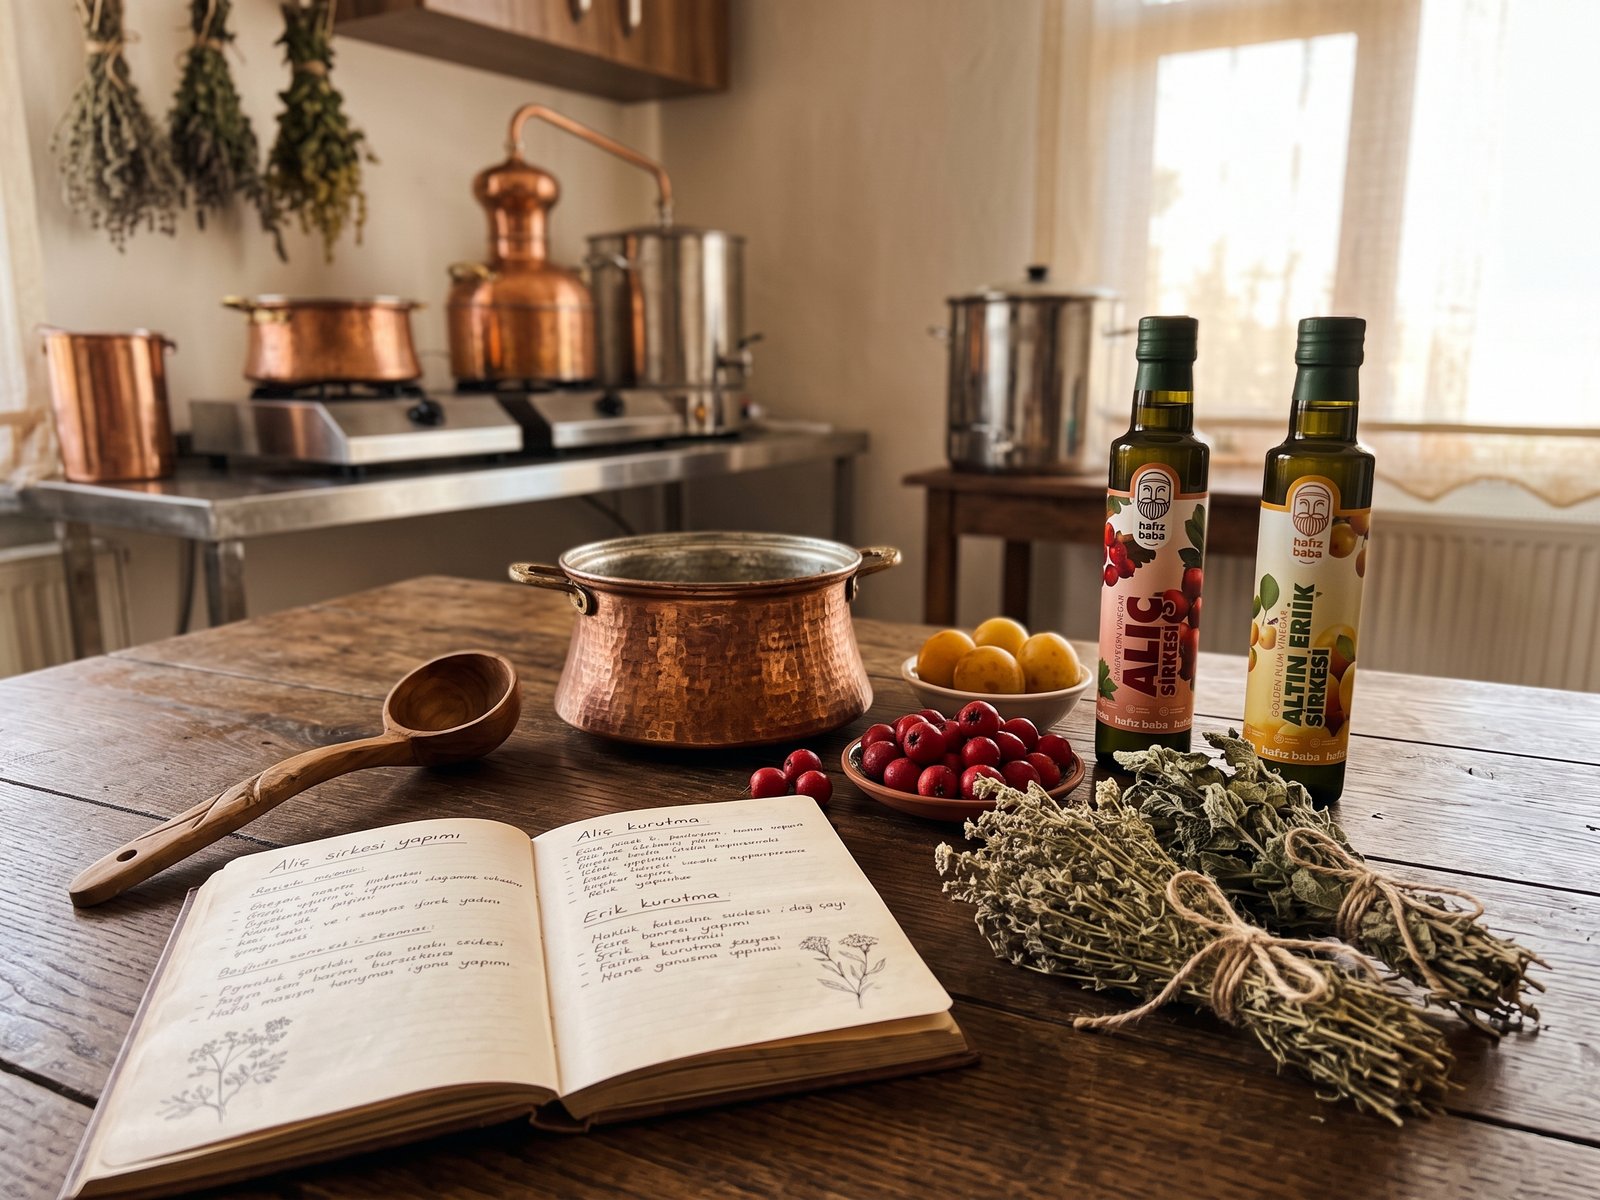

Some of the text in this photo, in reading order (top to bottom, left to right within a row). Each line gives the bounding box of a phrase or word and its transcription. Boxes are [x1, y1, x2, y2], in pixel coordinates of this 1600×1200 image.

[1138, 530, 1165, 540] baba
[1292, 547, 1322, 558] baba
[1271, 610, 1288, 718] GOLDEN PLUM VINEGAR
[1282, 655, 1308, 728] ALTIN
[1141, 720, 1169, 729] baba
[1291, 750, 1320, 761] baba
[576, 817, 700, 842] Aliç kurutma
[269, 858, 310, 874] Aliç
[325, 840, 387, 861] sirkesi
[394, 832, 461, 851] yapımı
[583, 892, 720, 924] Erik kurutma
